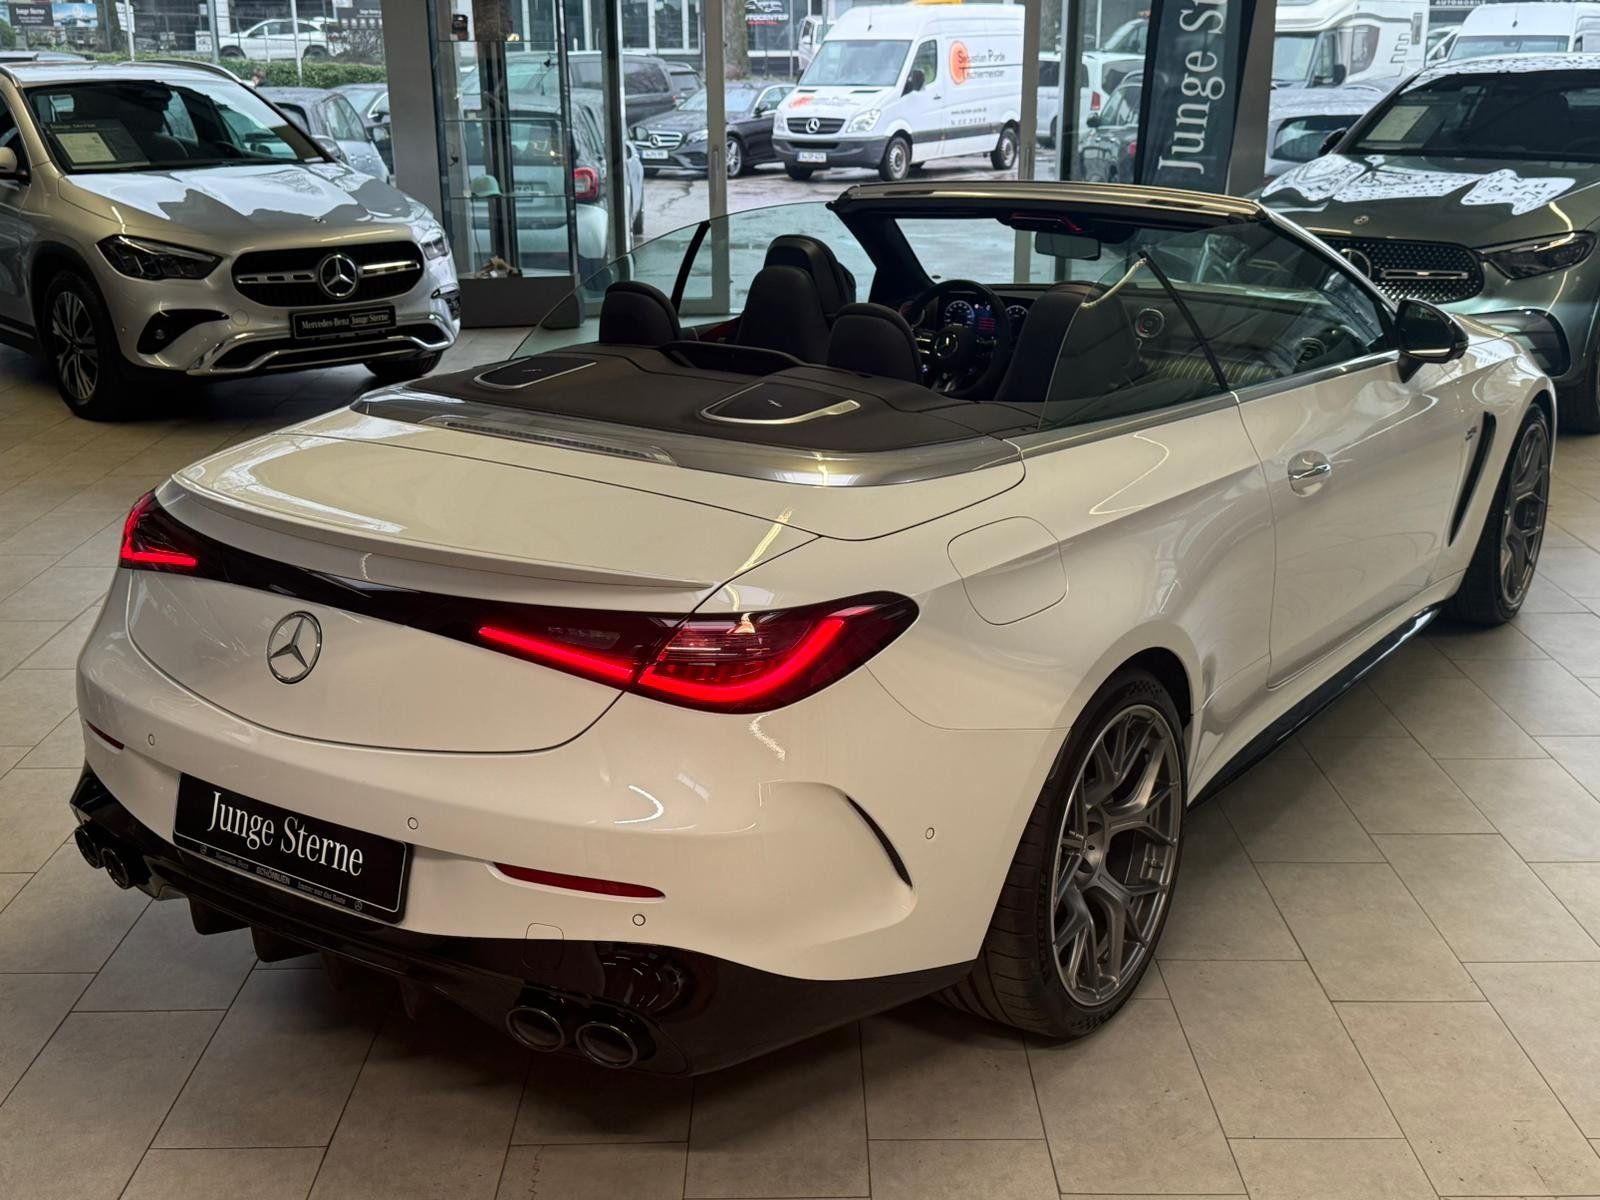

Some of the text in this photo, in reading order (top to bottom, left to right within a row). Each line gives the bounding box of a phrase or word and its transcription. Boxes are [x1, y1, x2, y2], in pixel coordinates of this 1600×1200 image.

[1157, 50, 1226, 175] Junge
[207, 790, 364, 877] Junge Sterne
